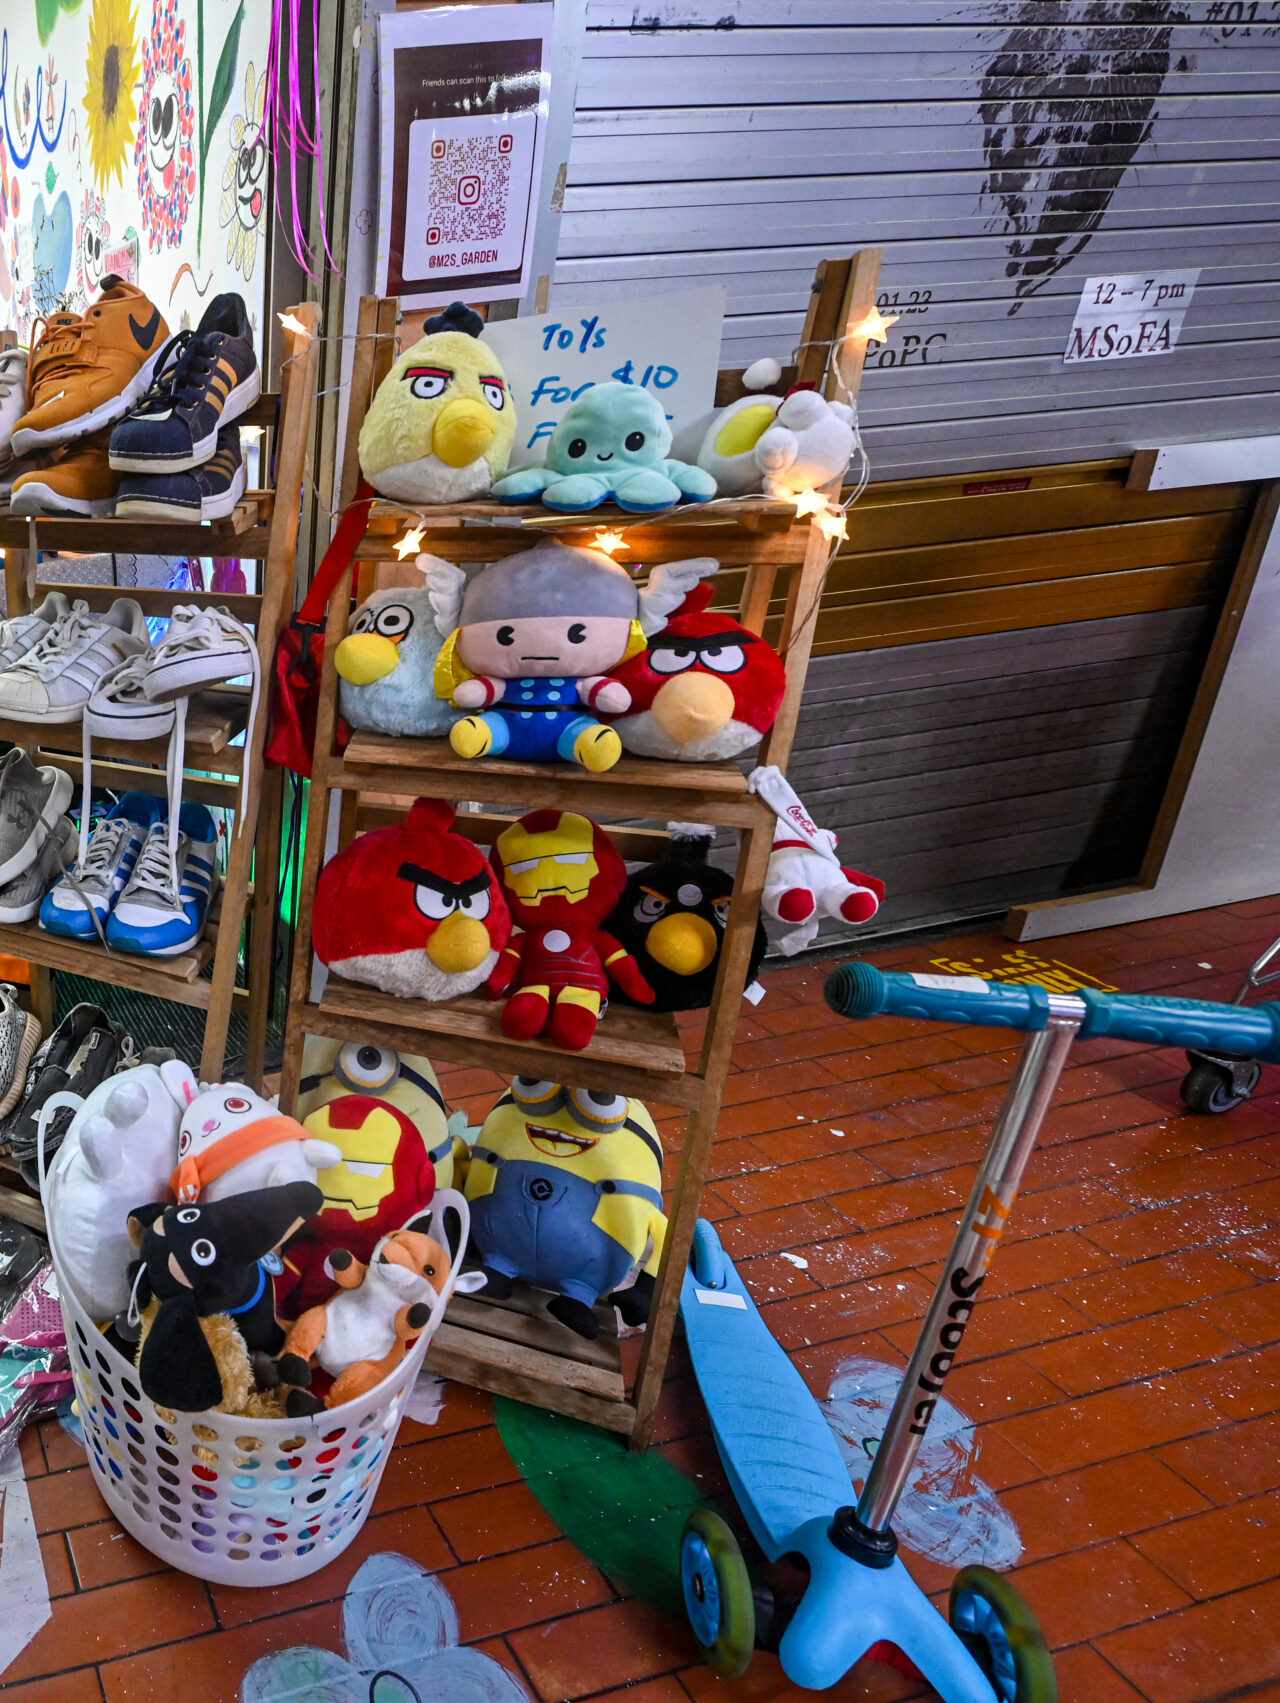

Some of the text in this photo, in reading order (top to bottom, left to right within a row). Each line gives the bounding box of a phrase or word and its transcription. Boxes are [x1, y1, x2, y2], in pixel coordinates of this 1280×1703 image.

[422, 79, 445, 87] Friends
[459, 77, 475, 85] scan
[475, 75, 487, 84] this
[428, 249, 499, 269] @M2S_GARDEN
[1092, 282, 1117, 305] 12
[1140, 279, 1155, 302] 7
[1142, 282, 1186, 308] pm
[1065, 318, 1171, 361] MSoFA
[530, 375, 597, 407] For
[611, 359, 679, 391] $10
